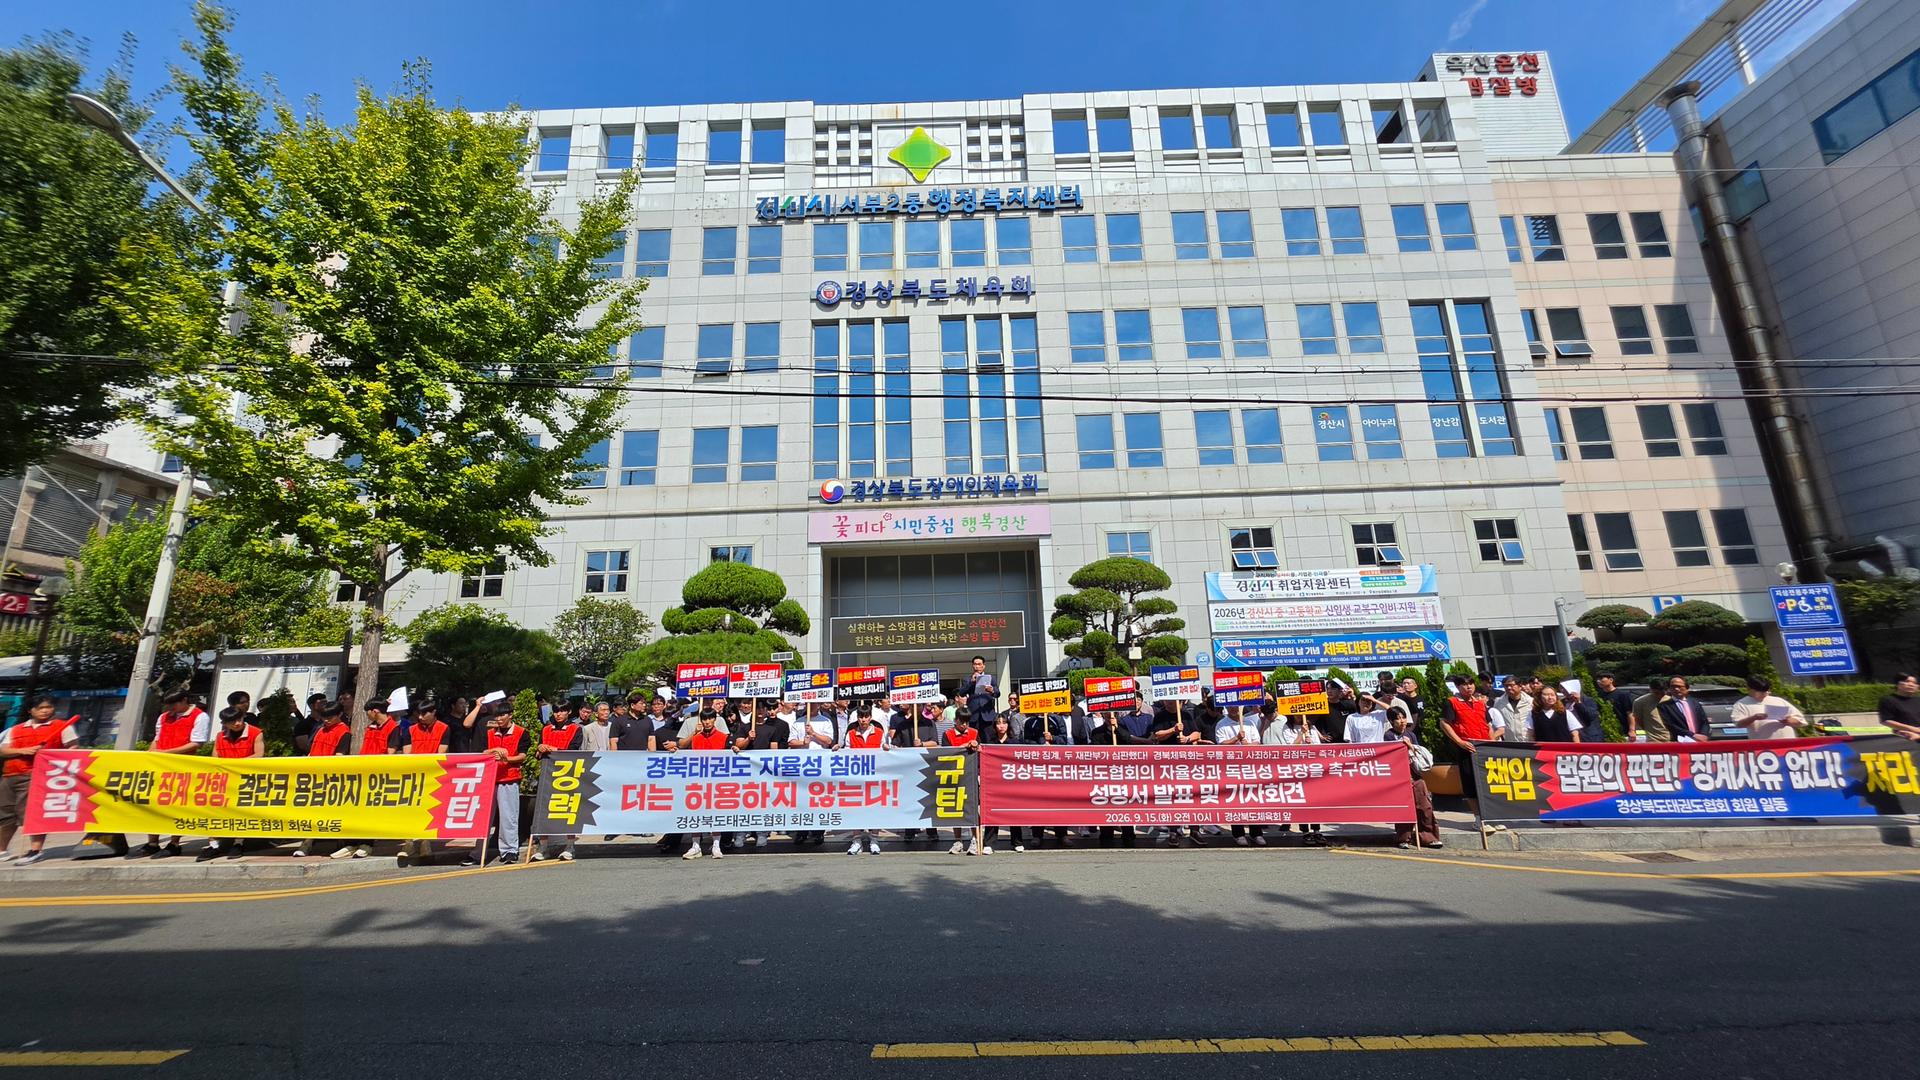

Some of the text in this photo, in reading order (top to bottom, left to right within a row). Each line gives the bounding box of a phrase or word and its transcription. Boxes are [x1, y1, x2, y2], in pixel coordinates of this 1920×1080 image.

[1446, 53, 1541, 75] 옥산온천
[845, 275, 1033, 301] 경상북도체육회
[1318, 415, 1506, 429] 경산시 아이누리 장난감 도서관
[851, 474, 1038, 502] 경상북도장애인체육회
[832, 512, 1028, 538] 꽃피다 시민중심 행복경산
[1236, 579, 1274, 592] 경산시
[1278, 577, 1351, 591] 취업지원센터
[2, 595, 25, 611] 2F
[1214, 607, 1245, 619] 2026년
[1325, 604, 1351, 617] 신입생
[1399, 601, 1417, 613] 지원
[1785, 599, 1797, 611] P
[848, 622, 885, 634] 실천하는
[929, 619, 966, 631] 실현되는
[855, 635, 883, 647] 침착한
[886, 634, 905, 645] 신고
[907, 633, 927, 645] 전화
[929, 632, 957, 644] 신속한
[1322, 638, 1425, 656] 체육대회 선수모집
[1258, 647, 1294, 656] 경산시민의
[1296, 646, 1304, 655] 날
[1305, 646, 1320, 655] 기념
[839, 687, 852, 697] 누가
[1021, 682, 1043, 694] 법원도
[1023, 698, 1037, 709] 근거
[1290, 701, 1326, 713] 심판했다!
[1014, 751, 1040, 760] 부당한
[1064, 751, 1073, 760] 두
[1075, 751, 1110, 761] 재판부가
[1153, 750, 1204, 761] 경북체육회는
[1206, 751, 1223, 760] 무릎
[1246, 750, 1280, 760] 사죄하고
[646, 754, 876, 779] 경북태권도 자율성 침해!
[1001, 760, 1392, 781] 경상북도태권도협회의 자율성과 독립성 보장을 촉구하는
[1556, 751, 1847, 793] 법원의 판단! 징계사유 없다!
[935, 755, 967, 818] 규탄
[1485, 757, 1536, 800] 책임
[43, 759, 81, 823] 강력
[104, 770, 425, 808] 무리한 징계 강행, 결단코 용납하지 않는다!
[444, 763, 485, 829] 규탄
[547, 759, 585, 825] 강력
[621, 779, 899, 811] 더는 허용하지 않는다!
[1089, 782, 1306, 805] 성명서 발표 및 기자회견
[1616, 797, 1789, 814] 경상북도태권도협회 회원 일동
[174, 818, 342, 833] 경상북도태권도협회 회원 일동
[676, 811, 842, 829] 경상북도태권도협회 회원 일동
[1105, 813, 1132, 823] 2026.
[1173, 812, 1190, 822] 오전
[1192, 812, 1212, 822] 10시
[1225, 811, 1281, 822] 경상북도체육회
[1283, 811, 1292, 821] 앞
